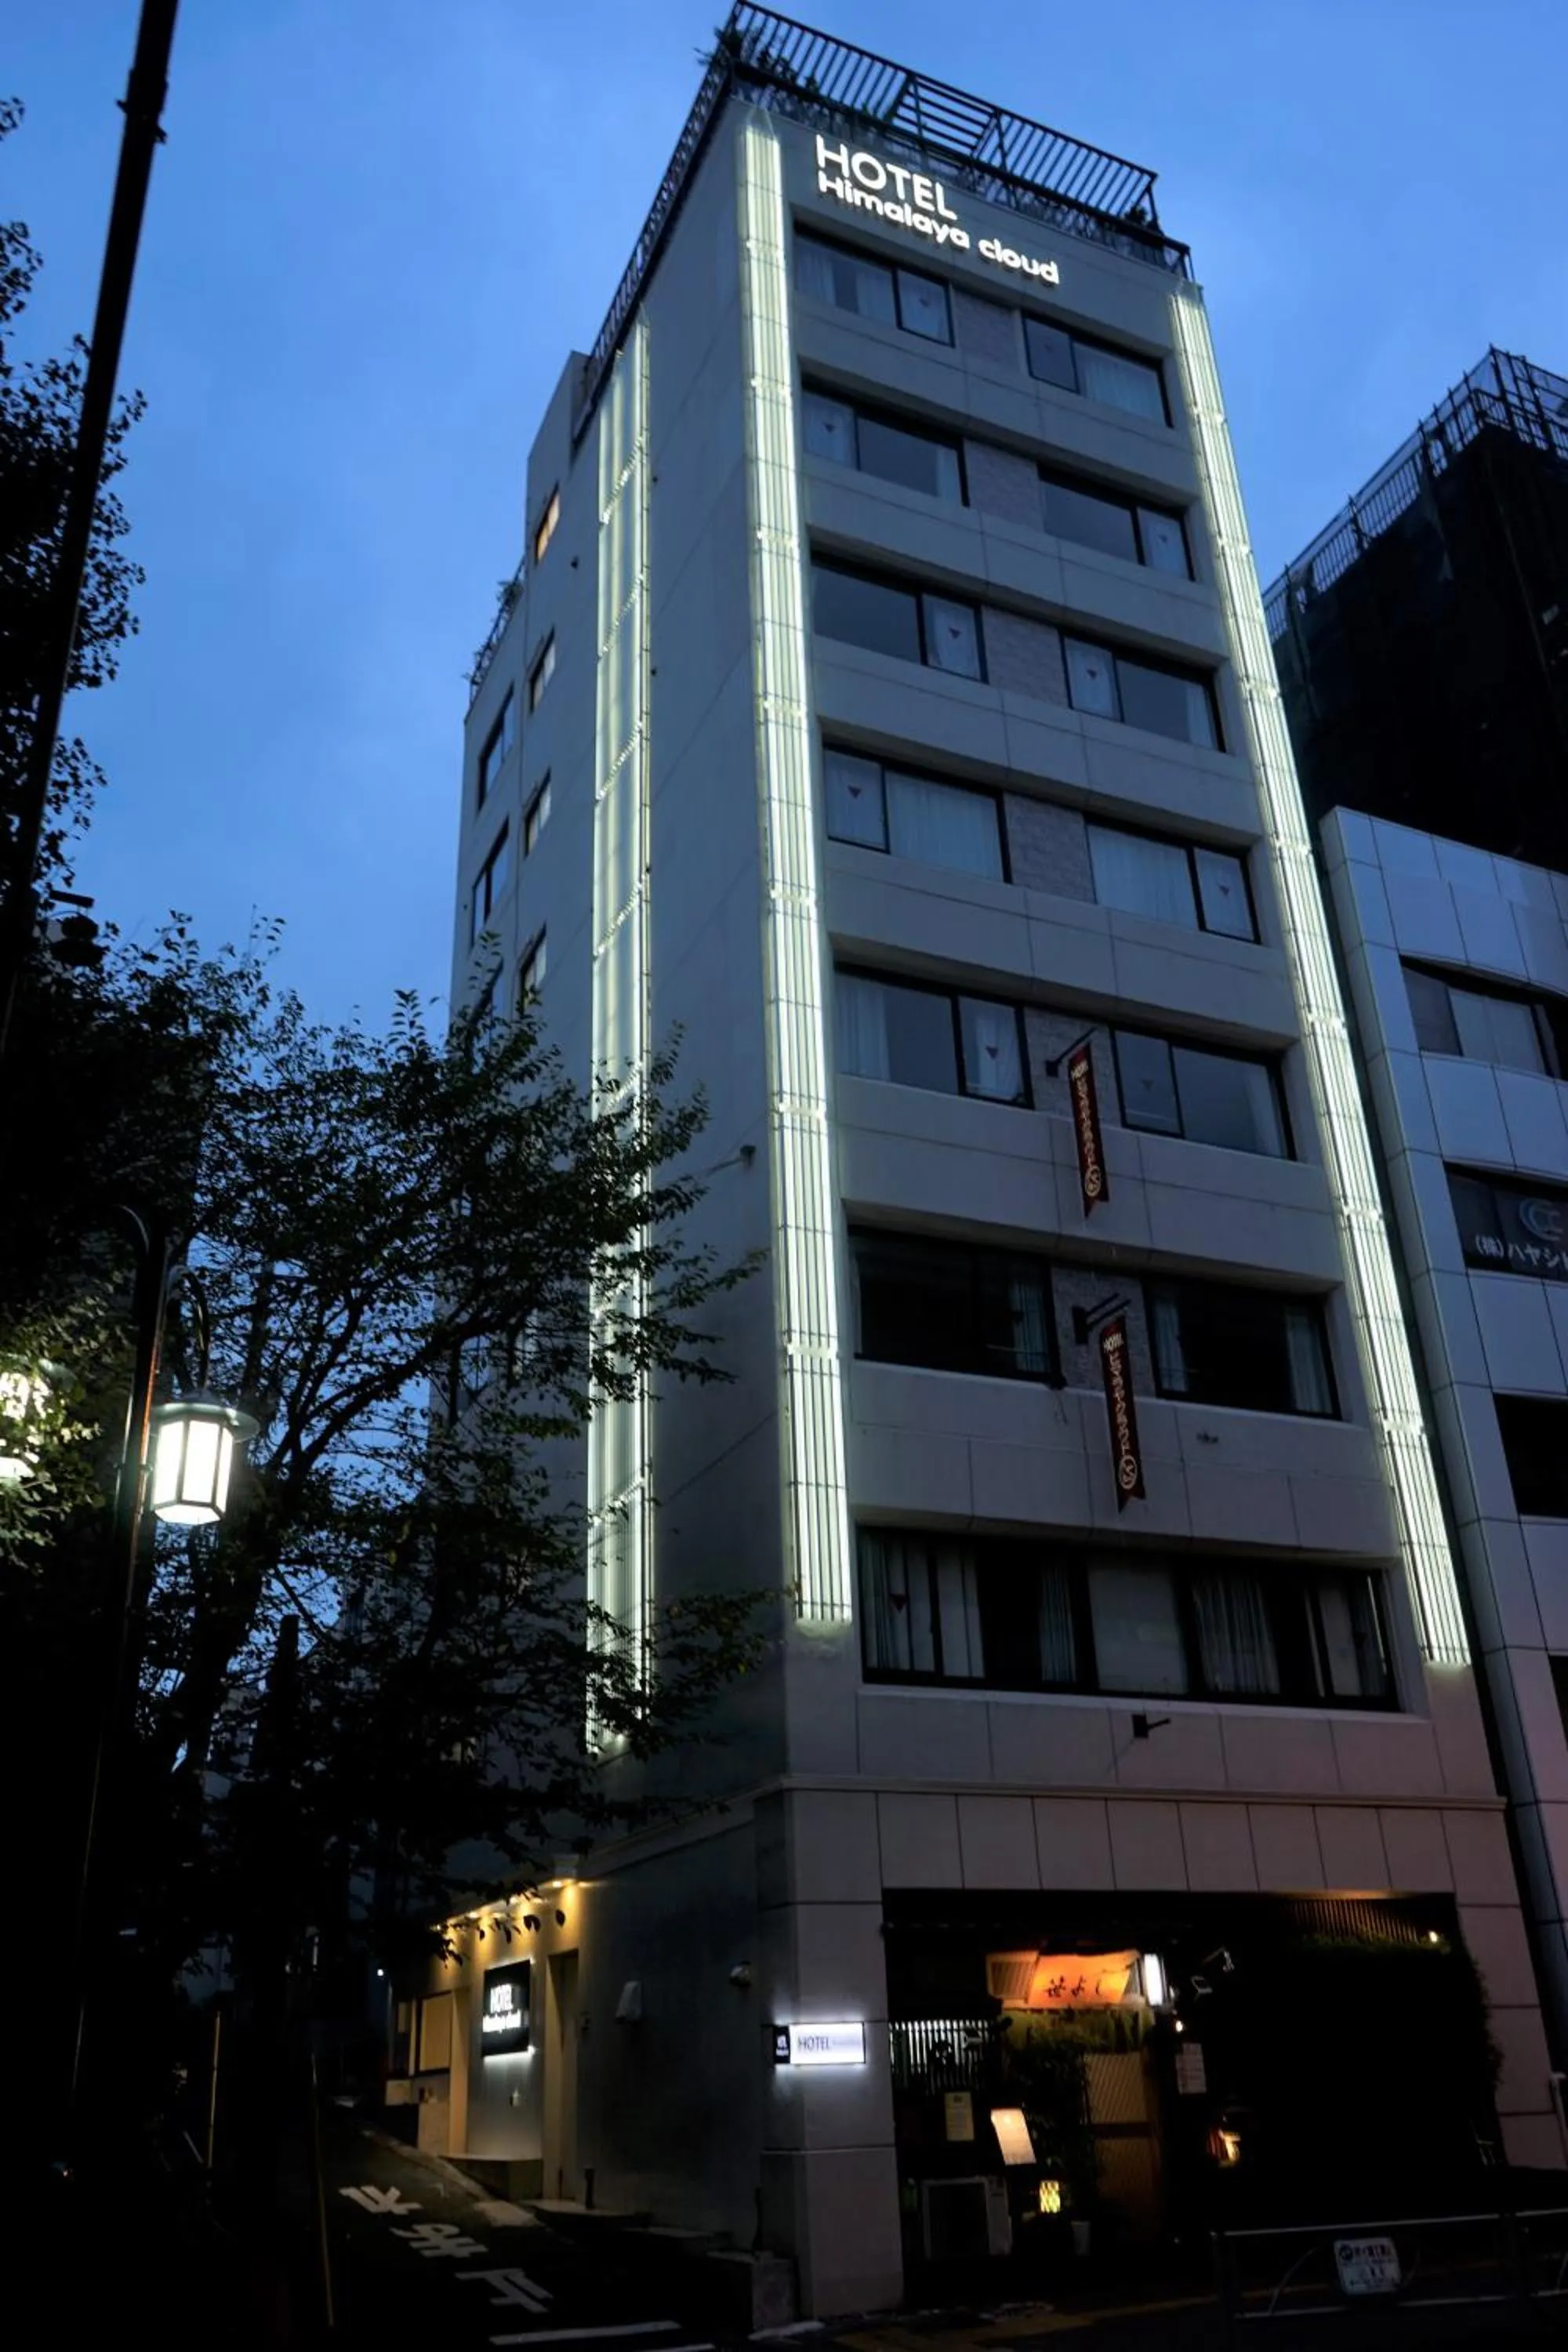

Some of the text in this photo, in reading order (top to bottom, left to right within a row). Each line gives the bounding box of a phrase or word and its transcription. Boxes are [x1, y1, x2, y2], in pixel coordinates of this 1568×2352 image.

[816, 134, 957, 220] HOTEL
[818, 170, 1060, 285] Himalaya cloud
[1475, 1233, 1568, 1269] (株)ハヤシ
[797, 2035, 831, 2052] HOTEL
